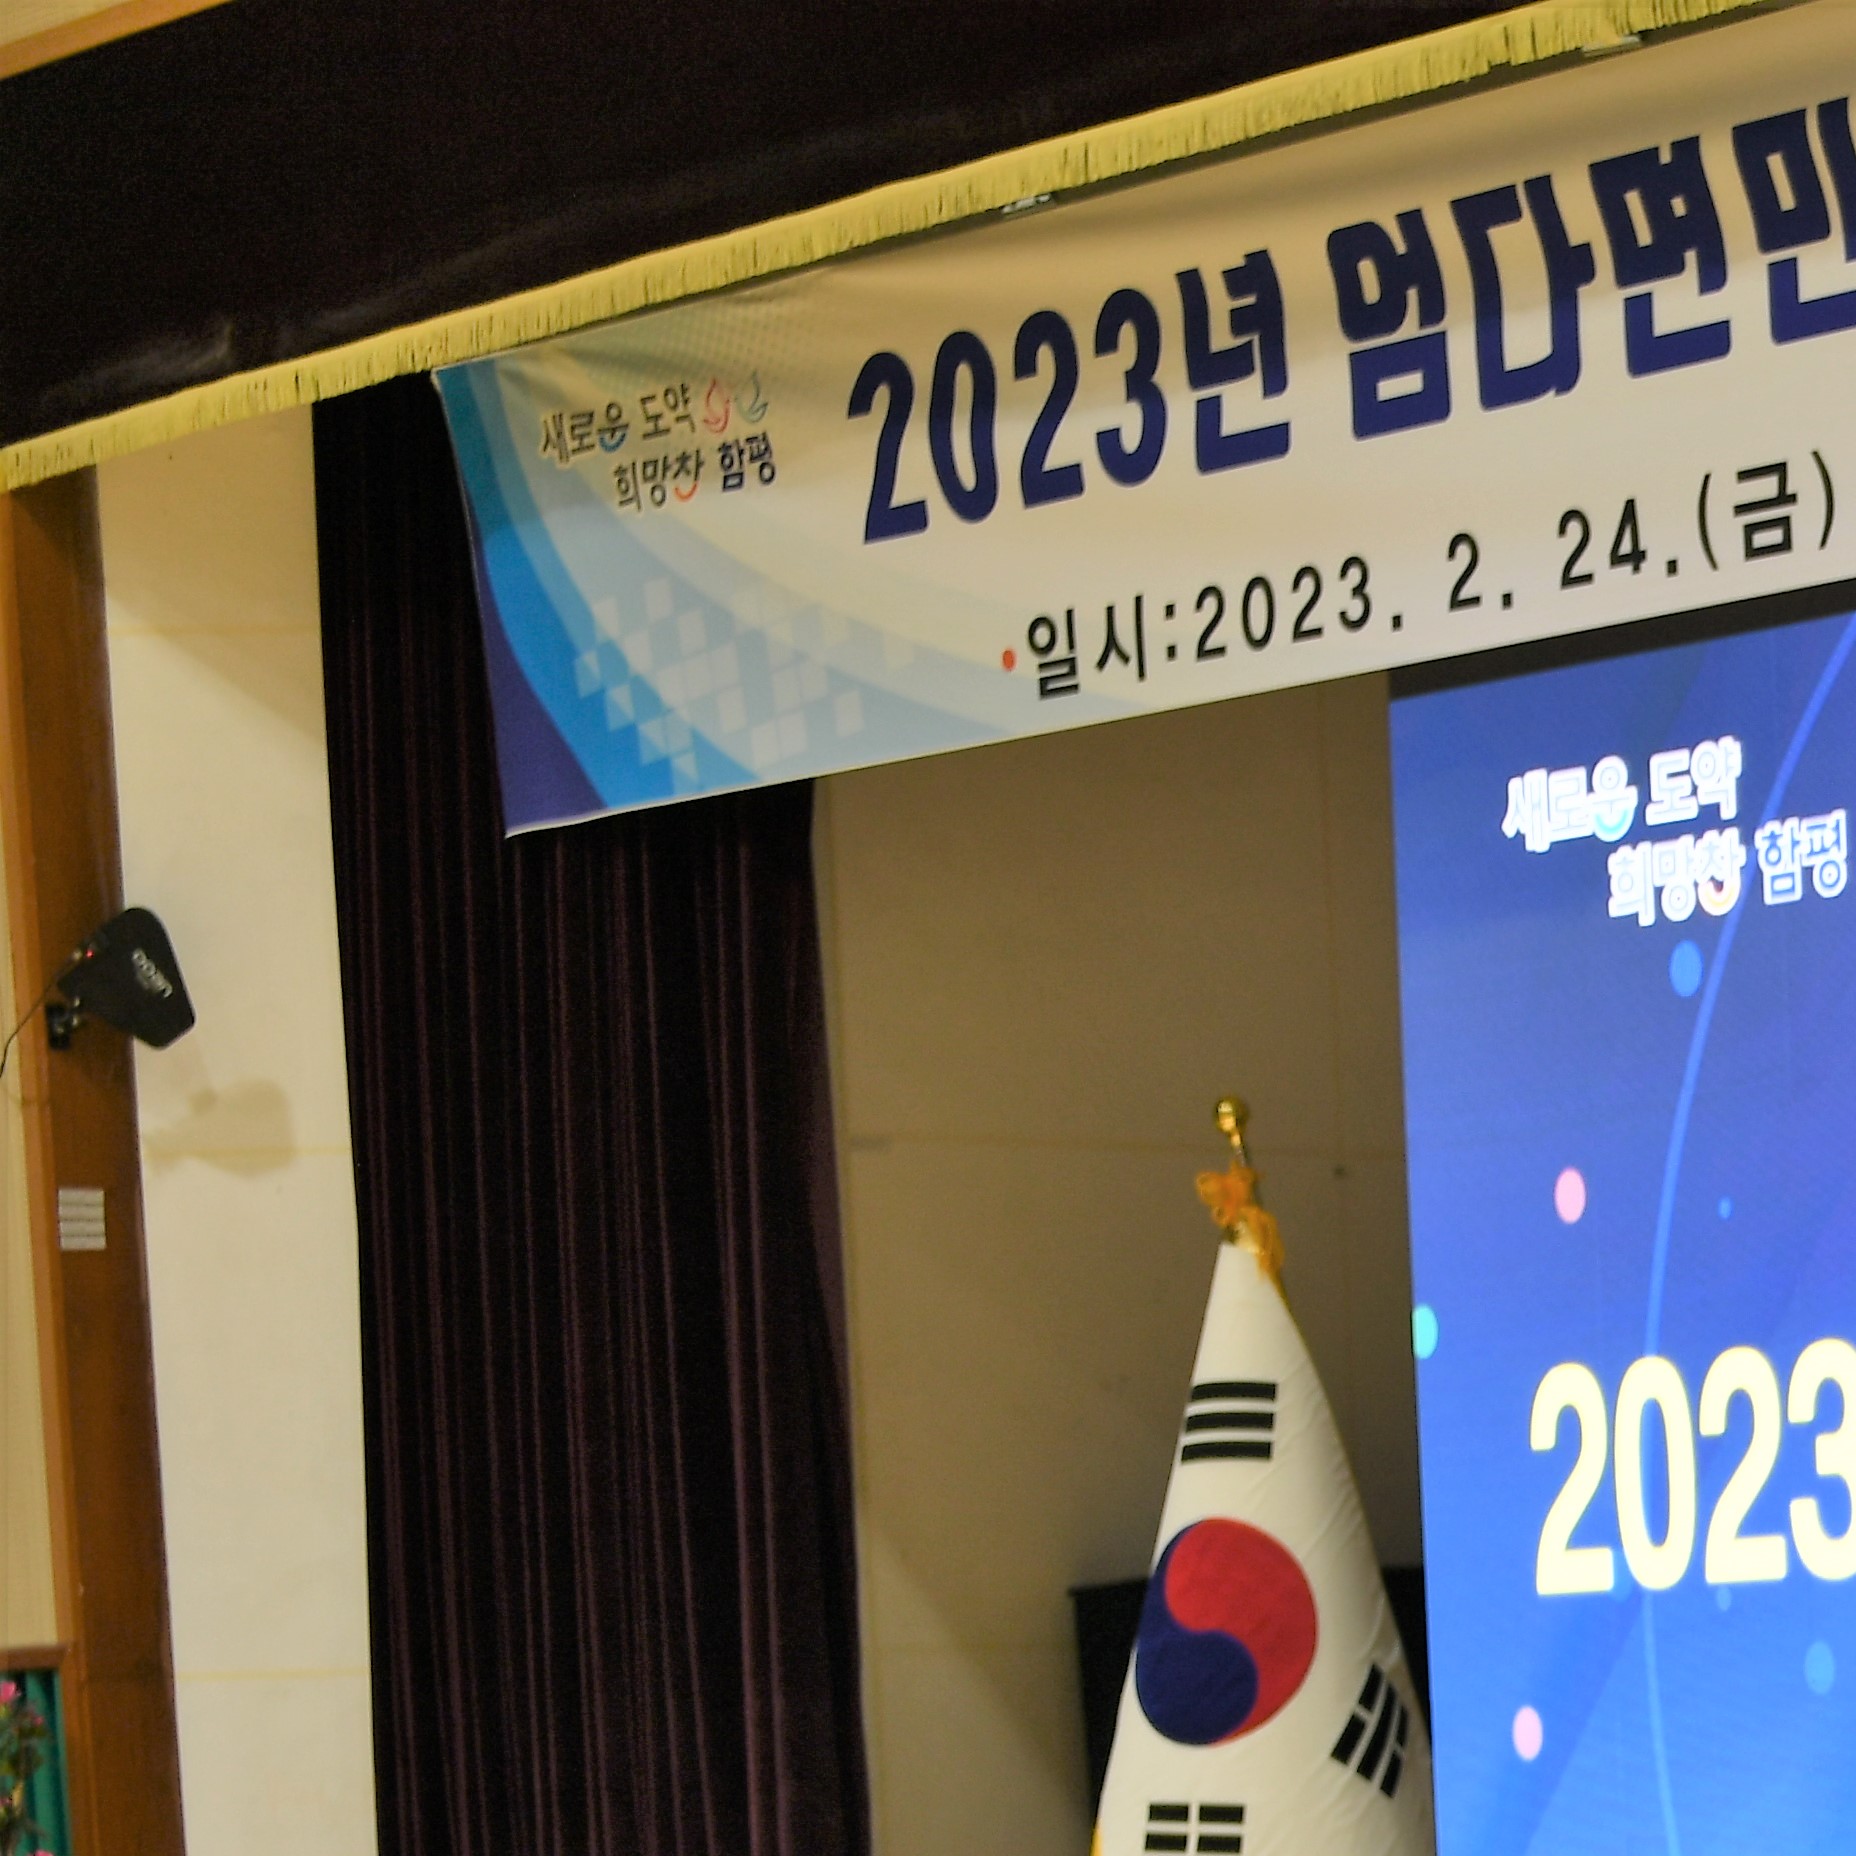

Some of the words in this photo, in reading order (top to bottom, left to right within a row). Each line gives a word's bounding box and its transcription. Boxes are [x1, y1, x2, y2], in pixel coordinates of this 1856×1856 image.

[541, 400, 630, 465] 새로운
[640, 382, 697, 441] 도약
[847, 249, 1291, 545] 2023년
[612, 448, 706, 512] 희망찬
[717, 430, 777, 493] 함평
[1446, 534, 1515, 611] 2.
[1501, 753, 1639, 854] 새로운
[1645, 734, 1744, 826] 도약
[1606, 826, 1747, 928] 희망찬
[1754, 808, 1849, 907] 함평
